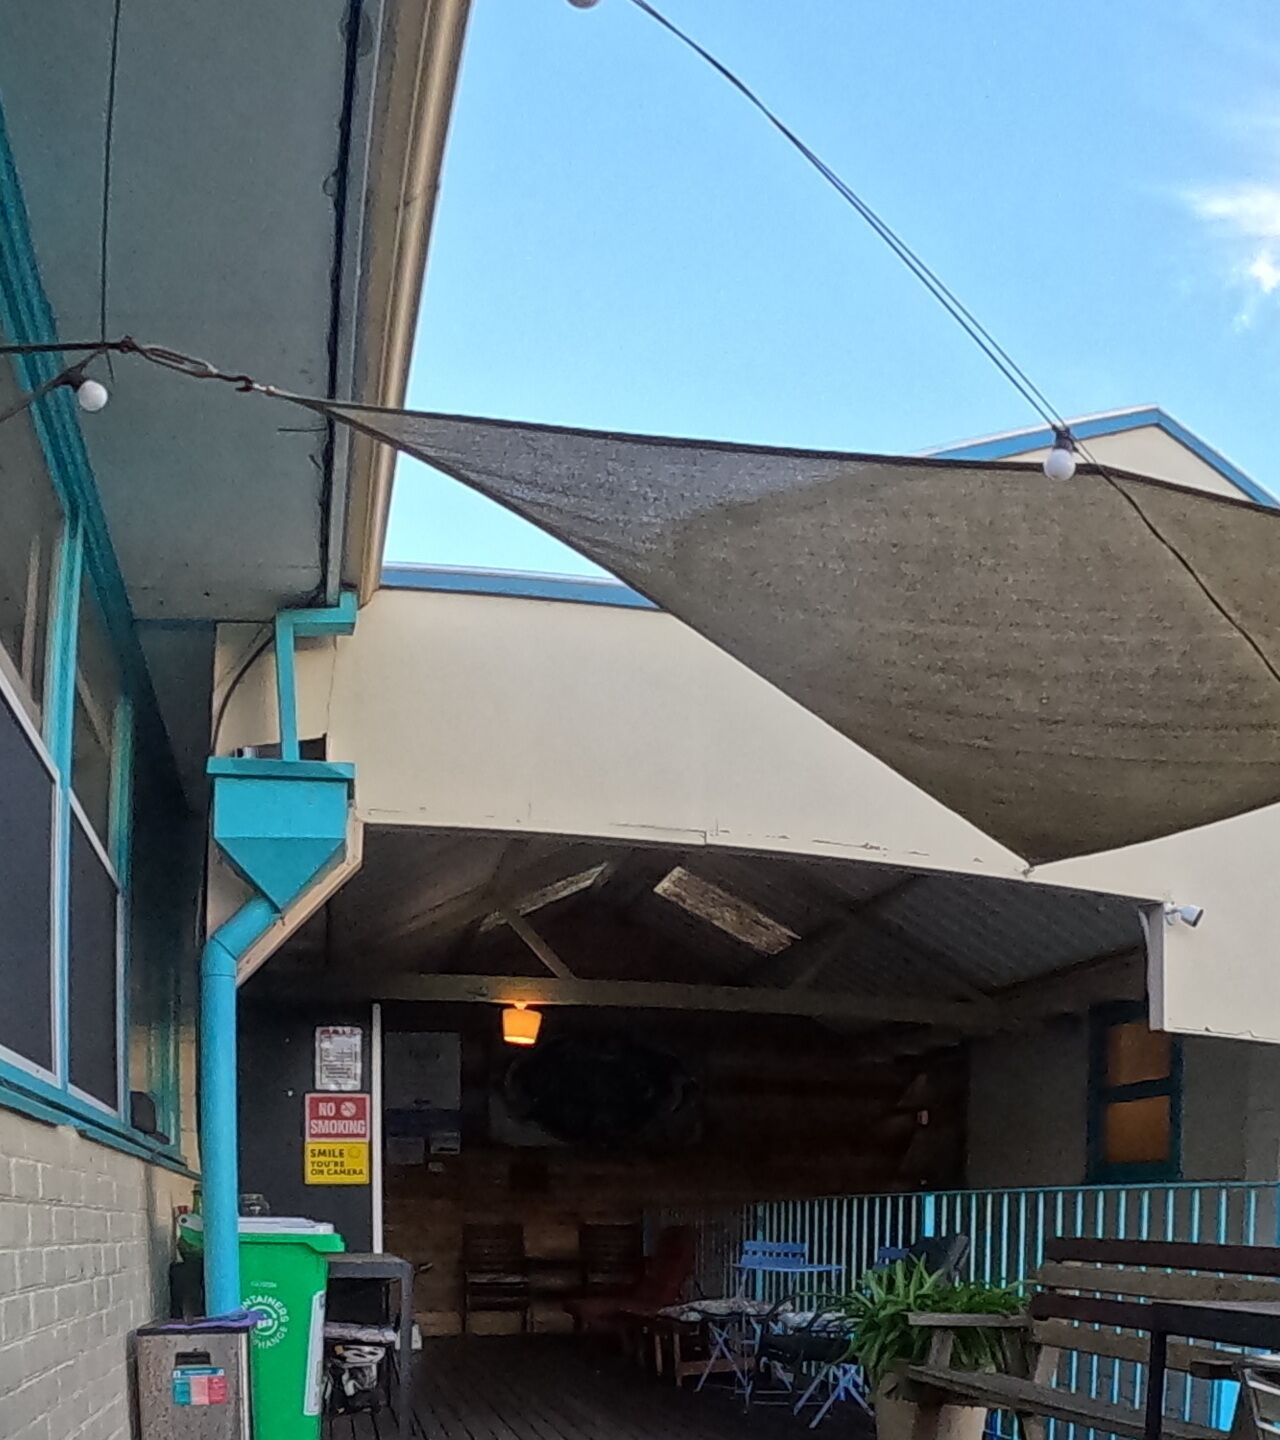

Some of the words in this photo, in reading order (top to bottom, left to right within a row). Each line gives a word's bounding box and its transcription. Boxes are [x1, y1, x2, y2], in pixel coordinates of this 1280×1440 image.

[318, 1102, 336, 1117] NO
[310, 1119, 366, 1135] SMOKING
[310, 1148, 345, 1158] SMILE
[310, 1160, 345, 1168] YOU'RE
[310, 1168, 325, 1176] ON
[326, 1168, 365, 1176] CAMERA
